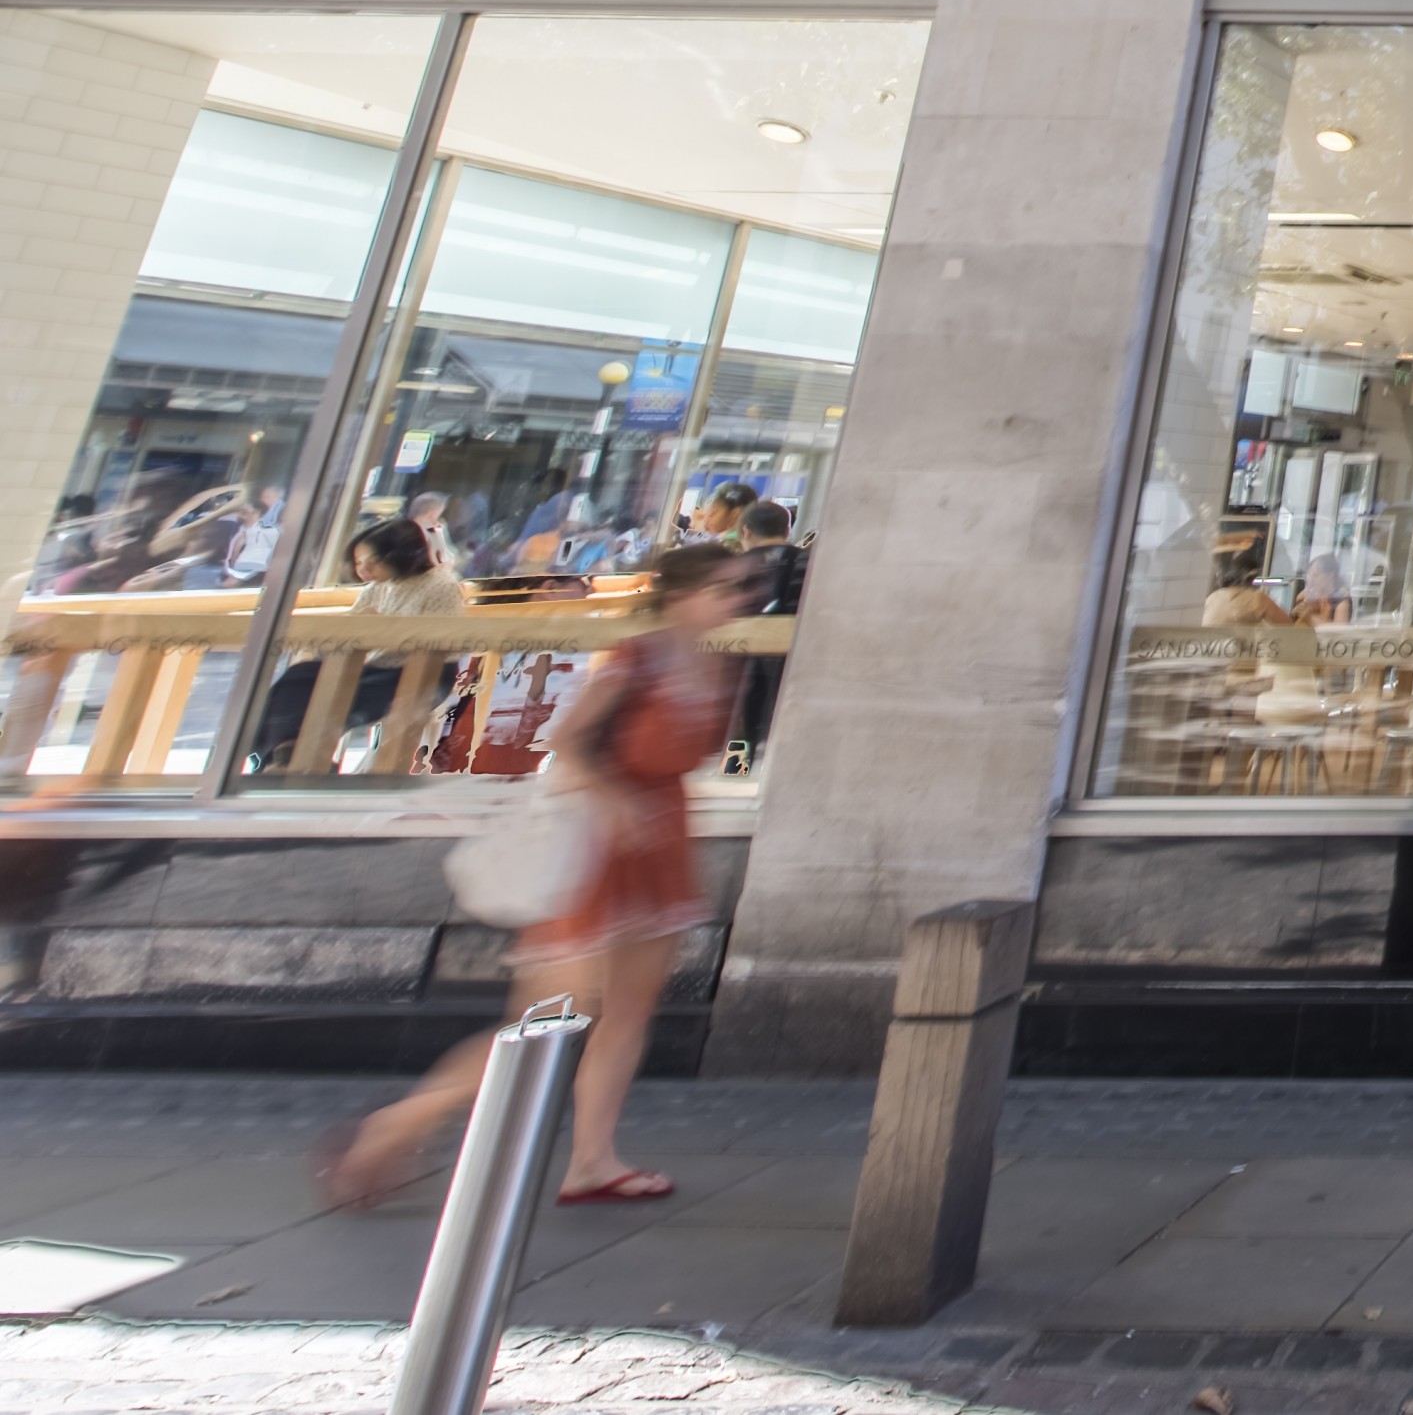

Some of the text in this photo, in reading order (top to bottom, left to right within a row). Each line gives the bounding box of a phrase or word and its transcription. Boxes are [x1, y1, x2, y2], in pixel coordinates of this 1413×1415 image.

[270, 636, 362, 657] SNACKS
[398, 637, 579, 656] CHILLED DRINKS
[1137, 638, 1281, 658] SANDWICHES
[1315, 639, 1360, 658] HOT
